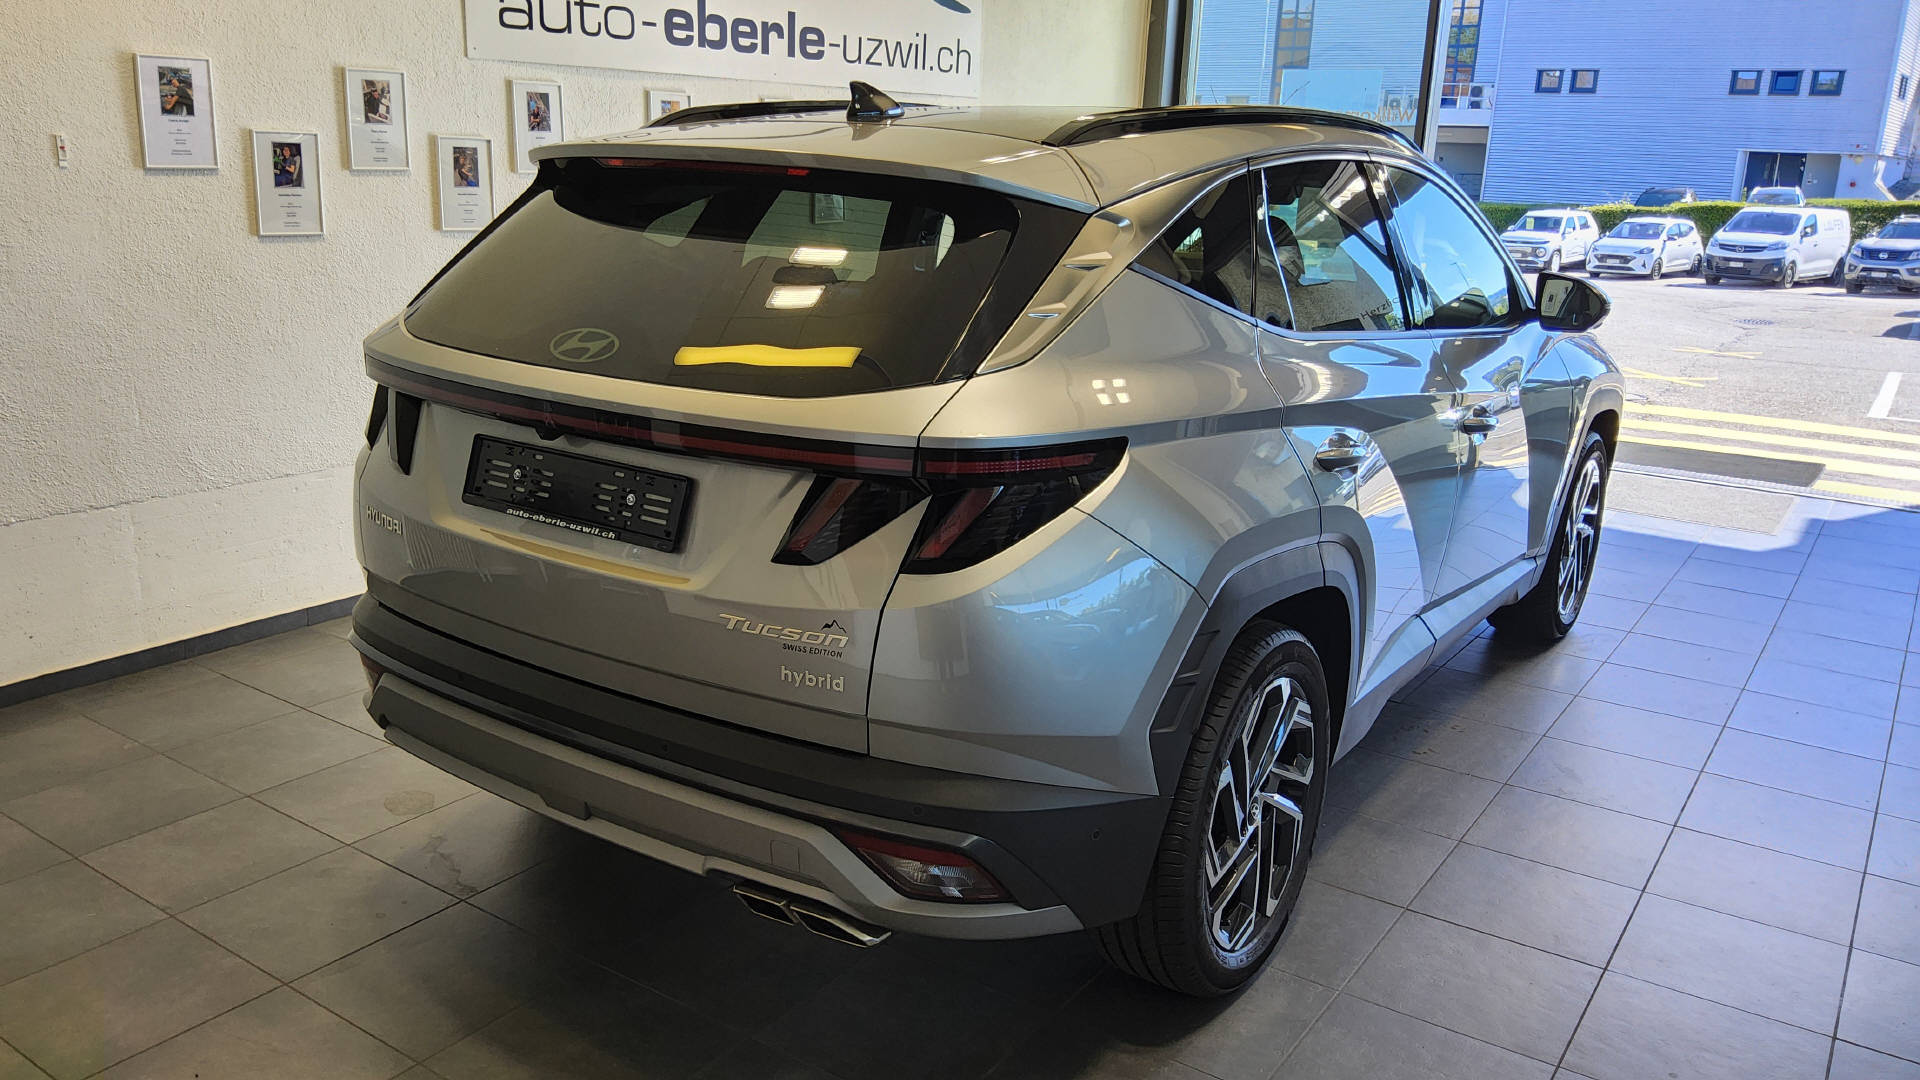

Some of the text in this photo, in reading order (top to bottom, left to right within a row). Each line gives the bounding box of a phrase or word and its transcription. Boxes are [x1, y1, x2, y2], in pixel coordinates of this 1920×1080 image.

[498, 0, 972, 75] auto-eberle-uzwil.ch
[366, 504, 402, 535] HYUNDAI
[506, 508, 616, 540] auto-eberle-uzwil.ch
[782, 643, 843, 658] SWISS EDITION
[781, 665, 844, 692] hybrid
